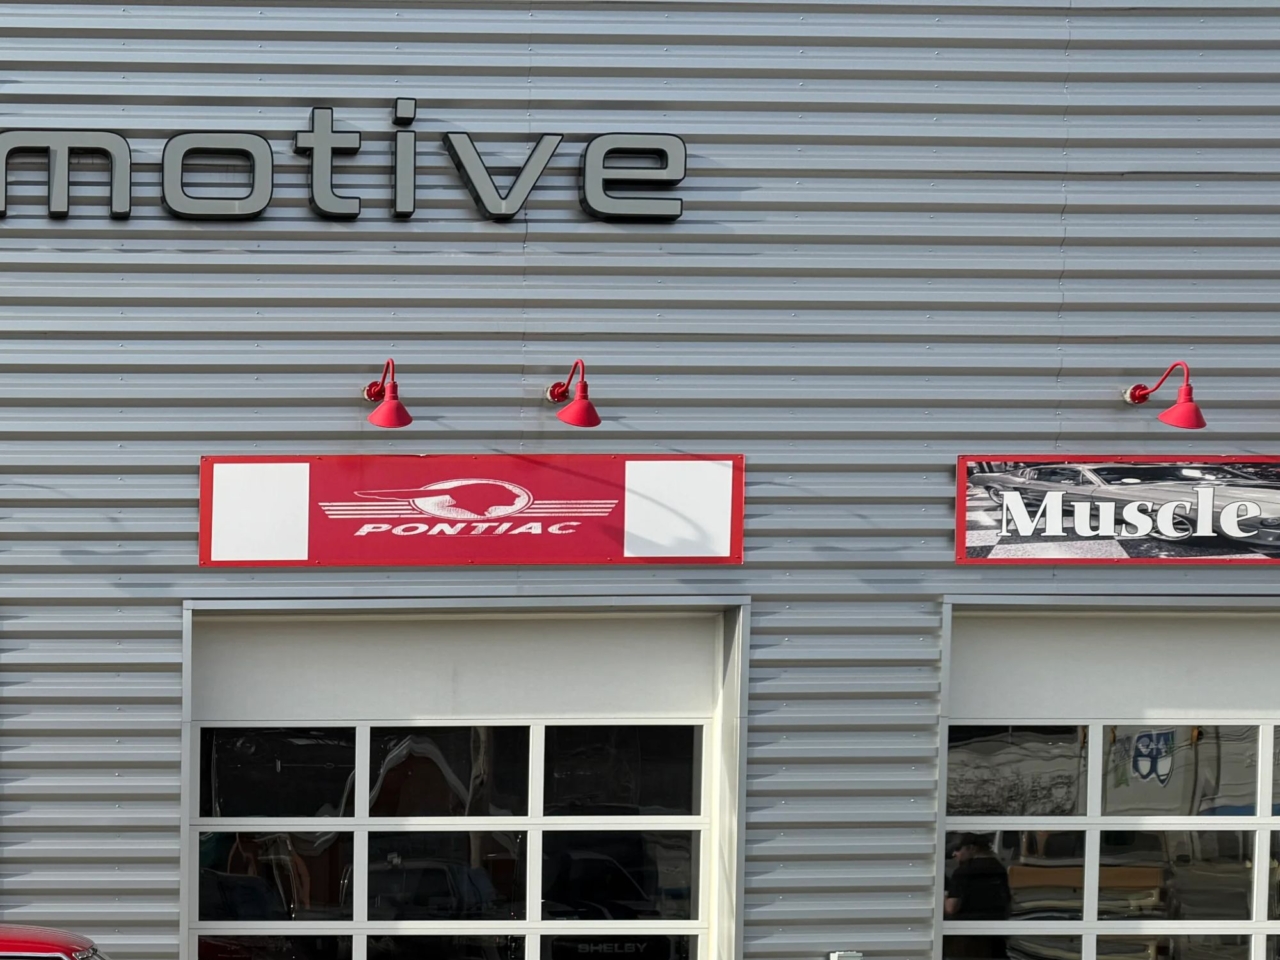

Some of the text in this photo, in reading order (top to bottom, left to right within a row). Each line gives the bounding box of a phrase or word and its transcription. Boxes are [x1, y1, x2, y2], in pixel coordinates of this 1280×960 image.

[997, 487, 1262, 538] Muscle
[353, 522, 581, 536] PONTIAC
[577, 942, 648, 953] SHELBY
